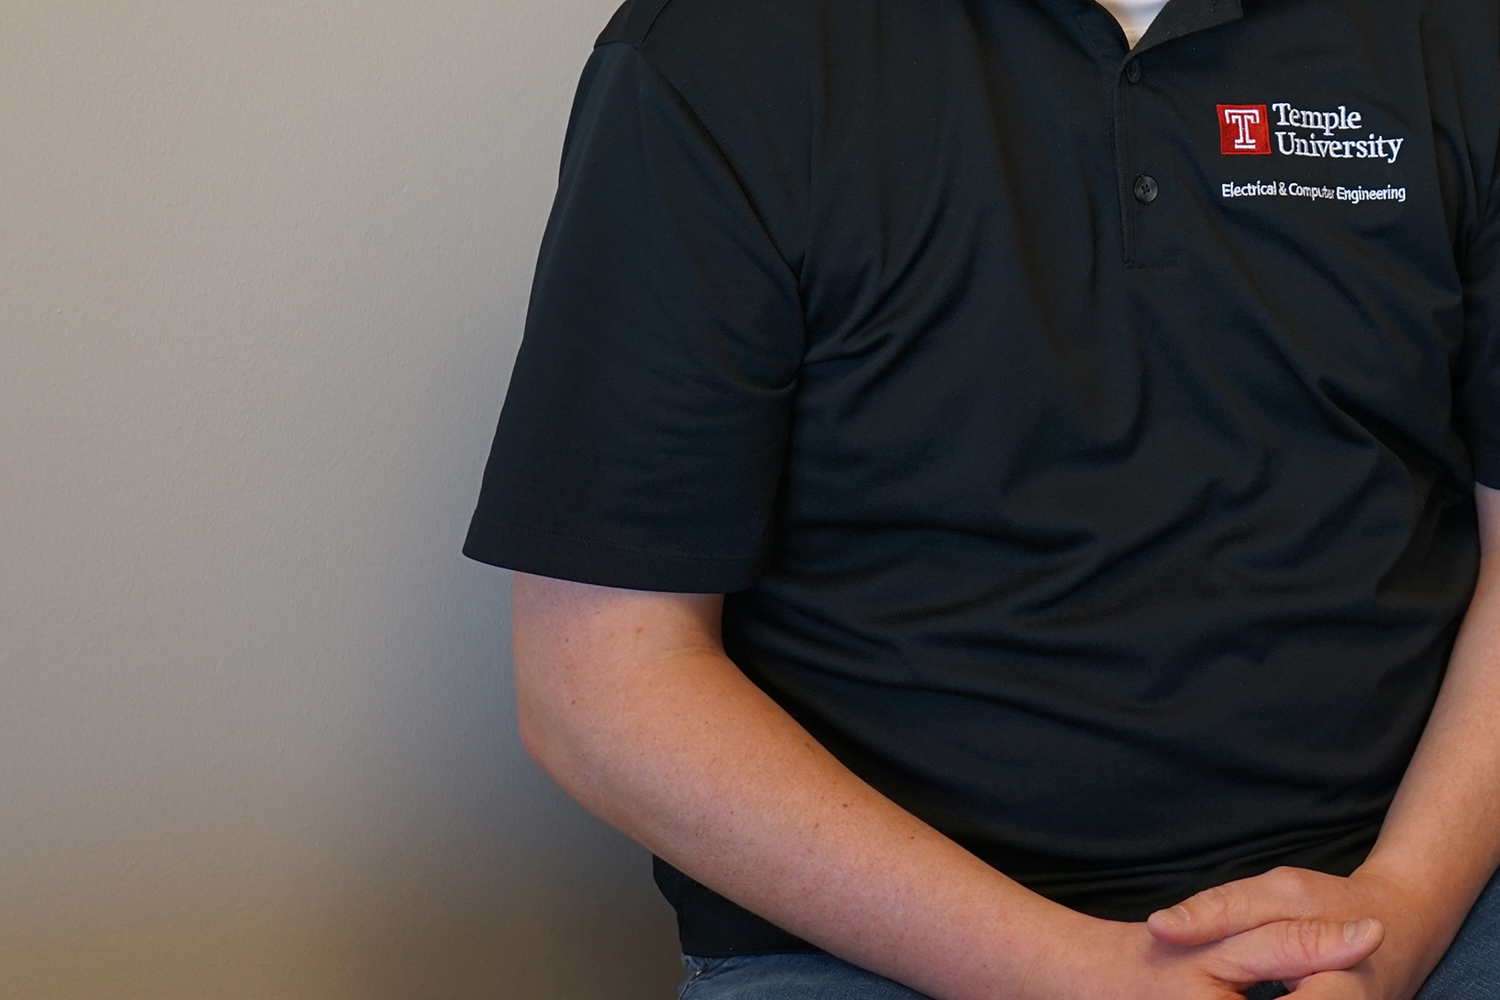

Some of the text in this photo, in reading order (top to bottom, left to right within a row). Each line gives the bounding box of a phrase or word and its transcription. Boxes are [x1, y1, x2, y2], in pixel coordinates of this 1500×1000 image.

[1272, 102, 1362, 136] Temple
[1275, 131, 1404, 164] University
[1221, 180, 1407, 204] Electrical & Computer Engineering
